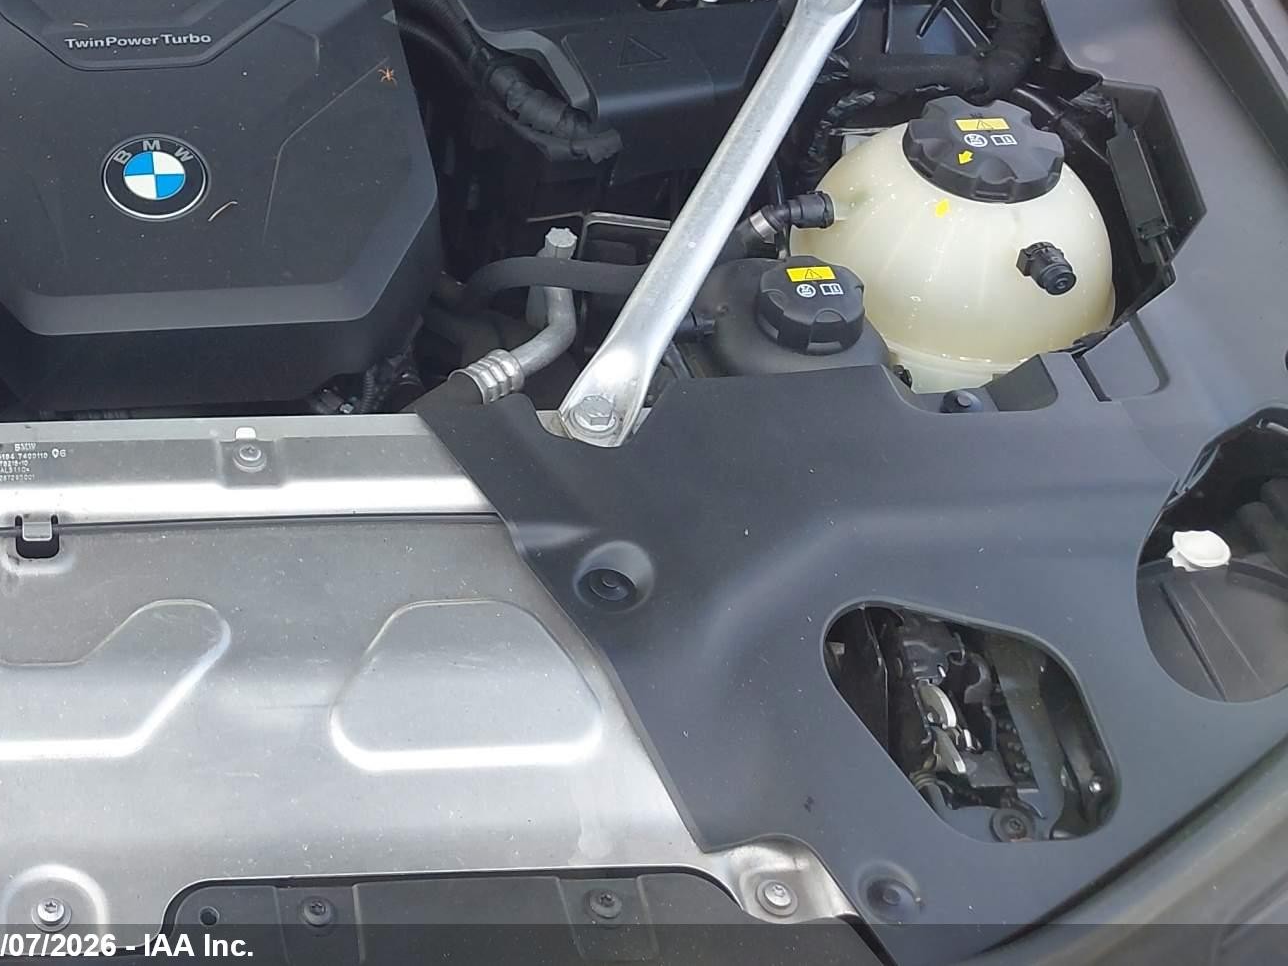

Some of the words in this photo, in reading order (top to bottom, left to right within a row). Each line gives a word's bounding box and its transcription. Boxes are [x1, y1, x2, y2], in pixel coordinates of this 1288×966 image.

[64, 36, 159, 48] TwinPower
[160, 33, 212, 44] Turbo
[113, 139, 194, 165] BMW
